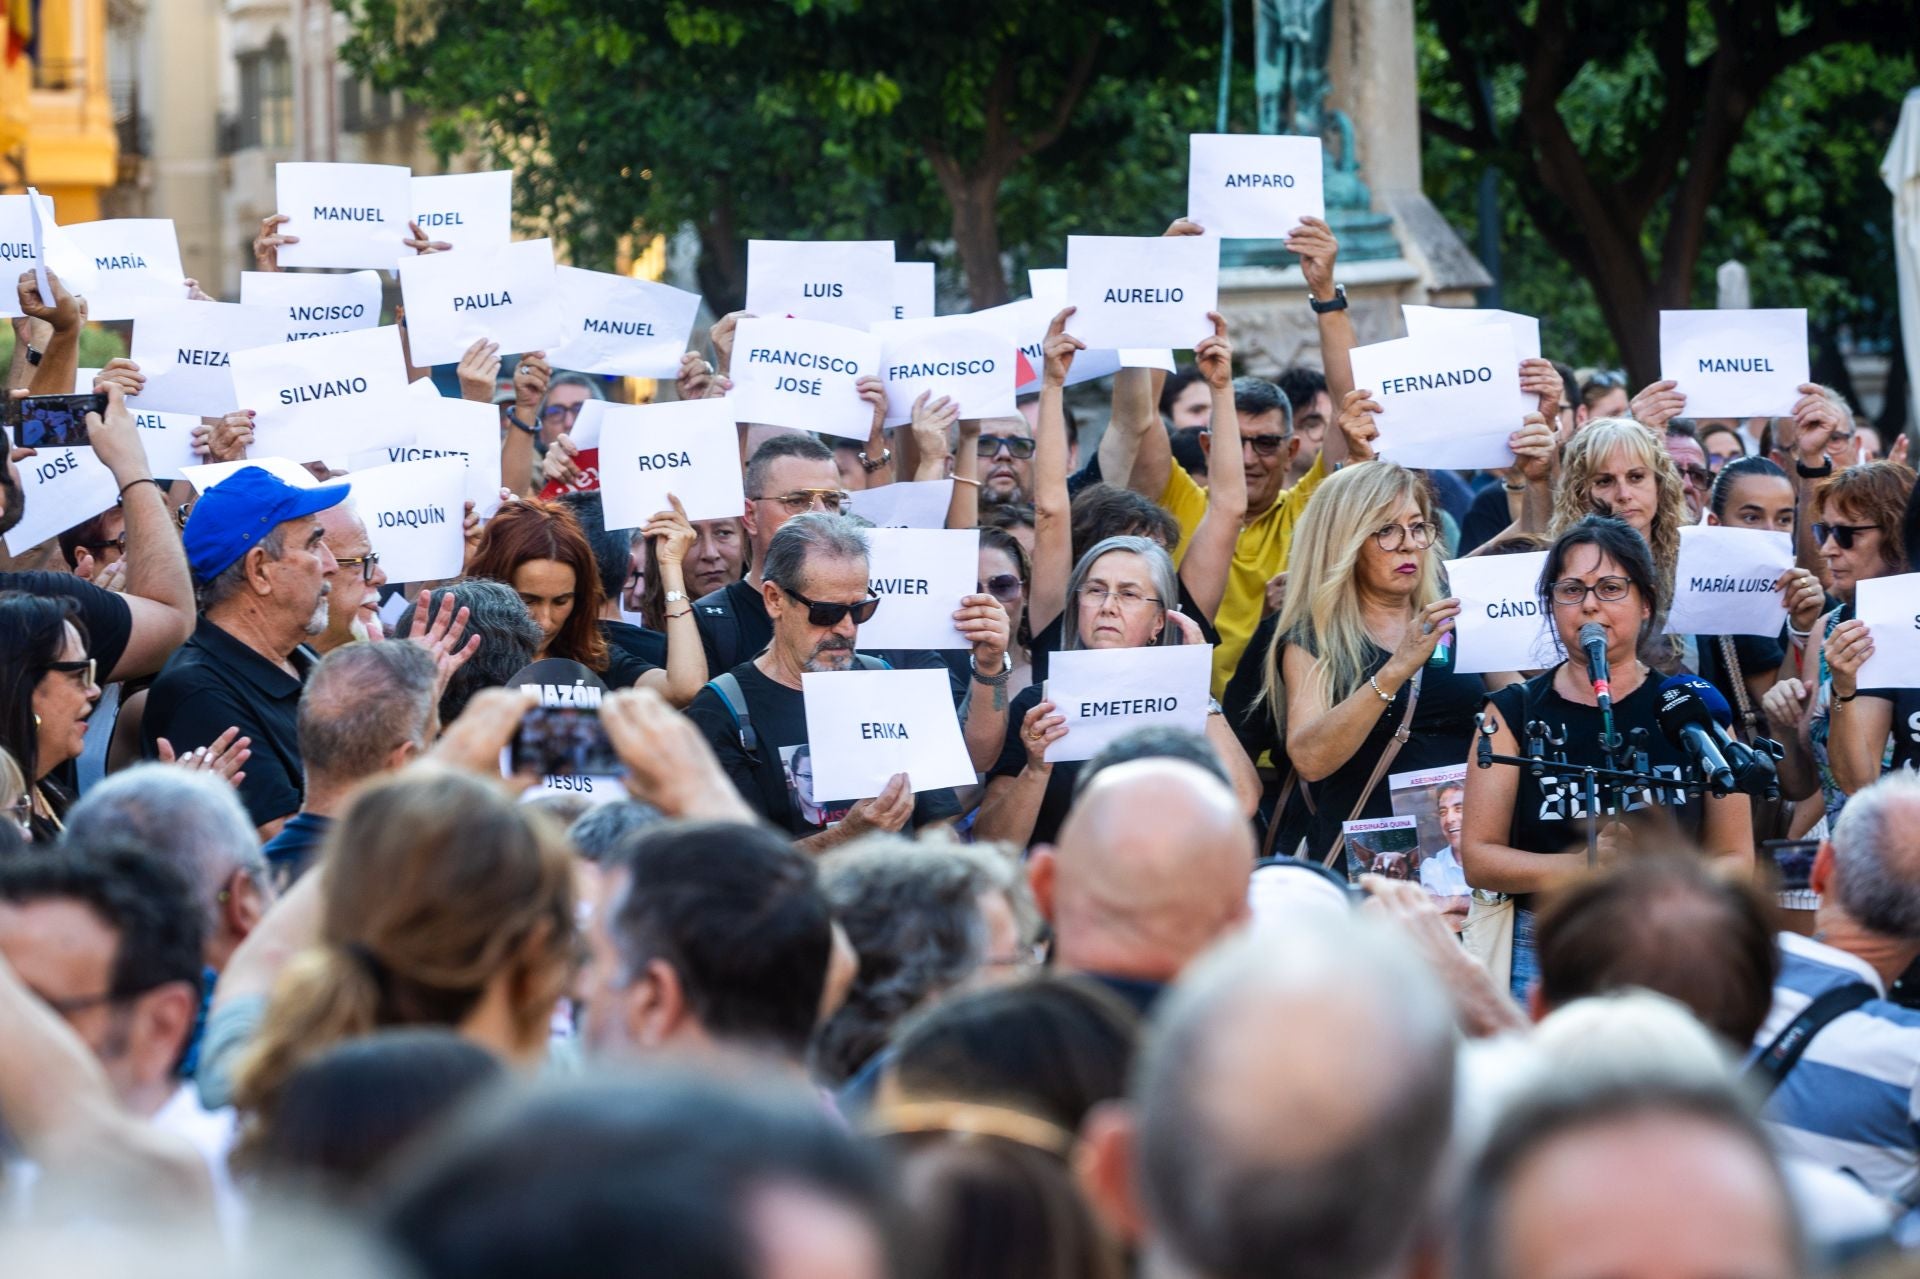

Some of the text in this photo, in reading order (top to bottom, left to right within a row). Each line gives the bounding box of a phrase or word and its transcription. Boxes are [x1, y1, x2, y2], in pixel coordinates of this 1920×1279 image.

[1224, 173, 1294, 188] AMPARO
[313, 206, 385, 223] MANUEL
[417, 212, 464, 227] FIDEL
[0, 243, 37, 261] QUEL
[96, 252, 147, 270] MARÍA
[803, 283, 844, 298] LUIS
[1103, 287, 1183, 304] AURELIO
[453, 291, 513, 312] PAULA
[289, 304, 364, 321] ANCISCO
[583, 317, 655, 337] MANUEL
[177, 348, 230, 367] NEIZA
[749, 348, 859, 376] FRANCISCO
[1698, 358, 1774, 373] MANUEL
[889, 359, 995, 381] FRANCISCO
[775, 377, 823, 396] JOSÉ
[1382, 366, 1493, 396] FERNANDO
[279, 377, 368, 405] SILVANO
[36, 449, 79, 484] JOSÉ
[638, 451, 692, 471] ROSA
[378, 504, 445, 528] JOAQUÍN
[1690, 574, 1779, 593] MARÍA LUISA
[1487, 598, 1543, 618] CÁND
[1080, 696, 1178, 718] EMETERIO
[861, 722, 909, 740] ERIKA
